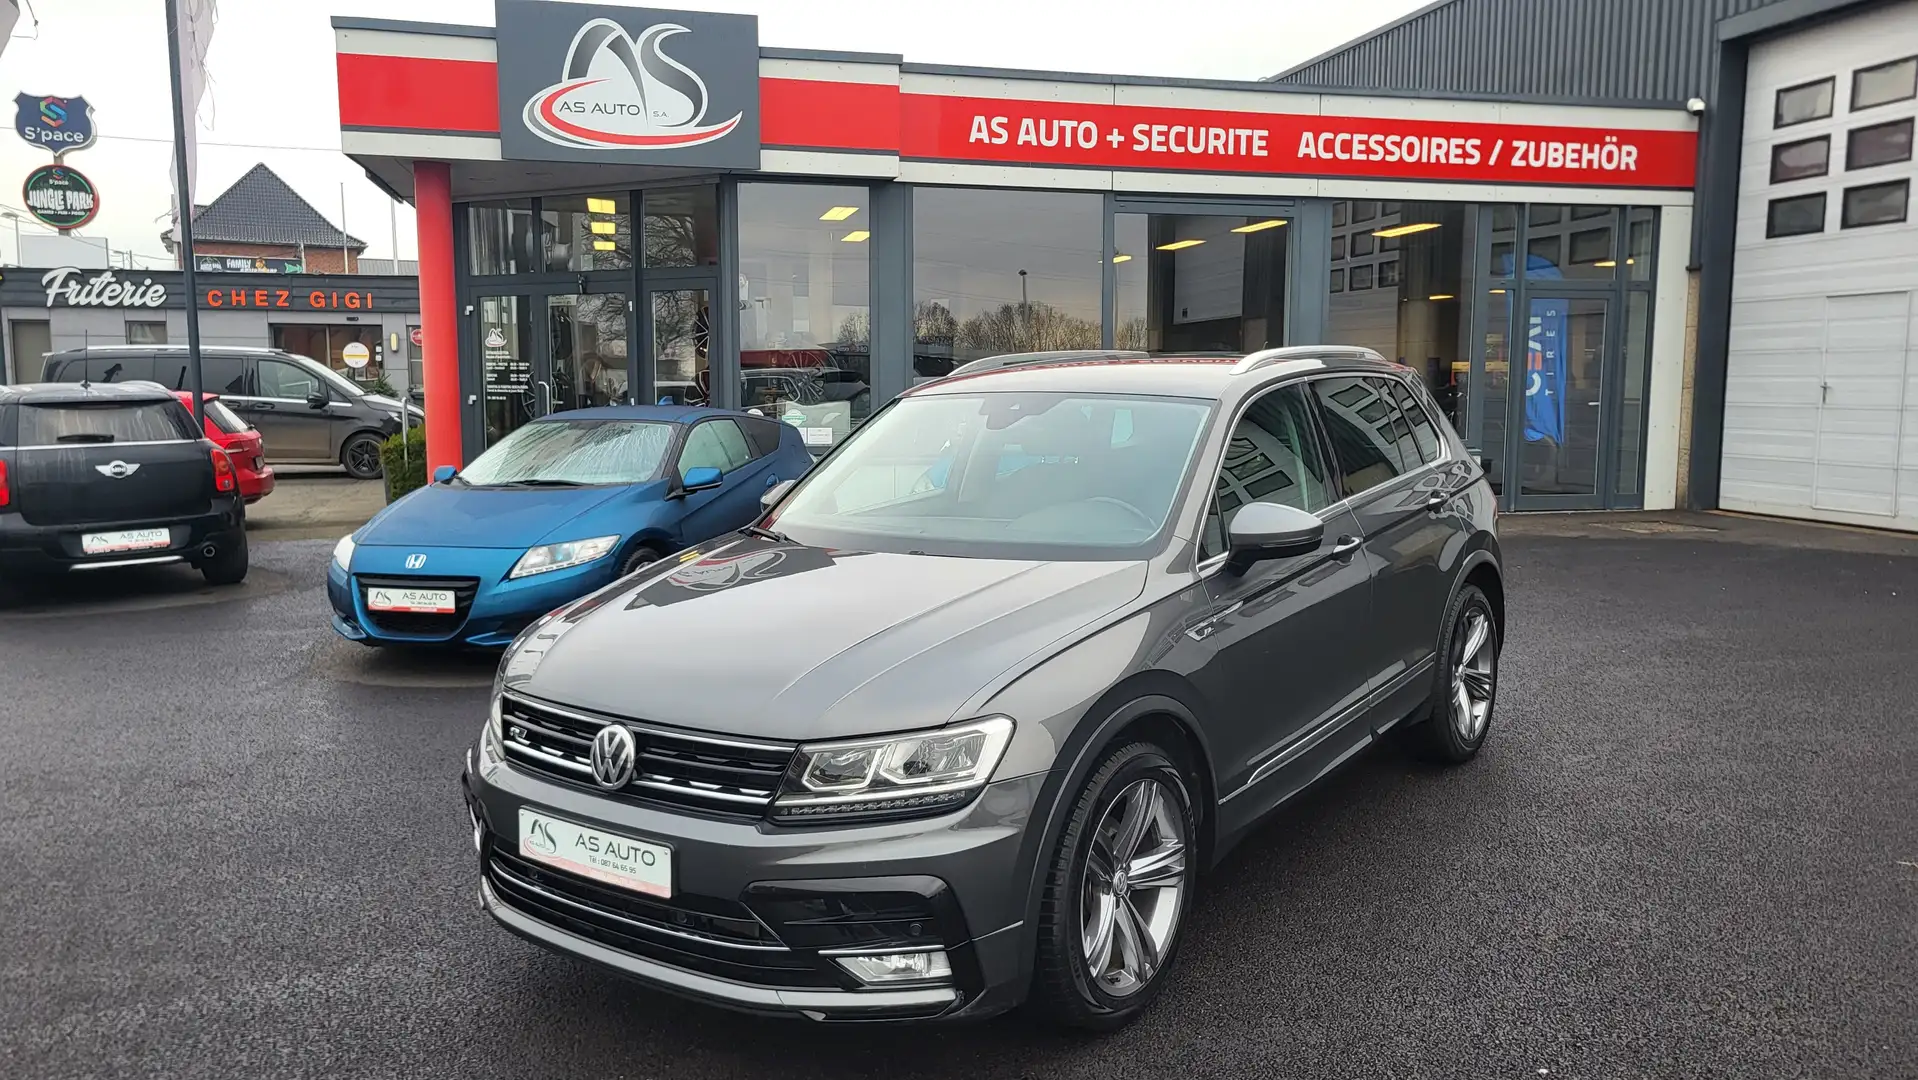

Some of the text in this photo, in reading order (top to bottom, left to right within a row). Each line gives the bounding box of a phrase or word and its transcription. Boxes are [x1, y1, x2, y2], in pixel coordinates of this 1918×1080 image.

[558, 100, 641, 116] AS AUTO
[652, 110, 670, 118] S.A.
[24, 126, 85, 143] S'pace
[968, 115, 1009, 145] AS
[1016, 117, 1098, 149] AUTO
[1132, 123, 1269, 157] SECURITE
[1297, 131, 1481, 166] ACCESSOIRES
[1510, 135, 1638, 171] ZUBEHÖR
[27, 188, 94, 211] JUNGLE PARK
[226, 258, 252, 269] FAMILY
[41, 266, 168, 307] Friterie
[207, 289, 373, 309] CHEZ GIGI
[1544, 309, 1556, 396] TIRES
[120, 530, 163, 540] AS AUTO
[402, 592, 448, 601] AS AUTO
[574, 832, 656, 867] AS AUTO
